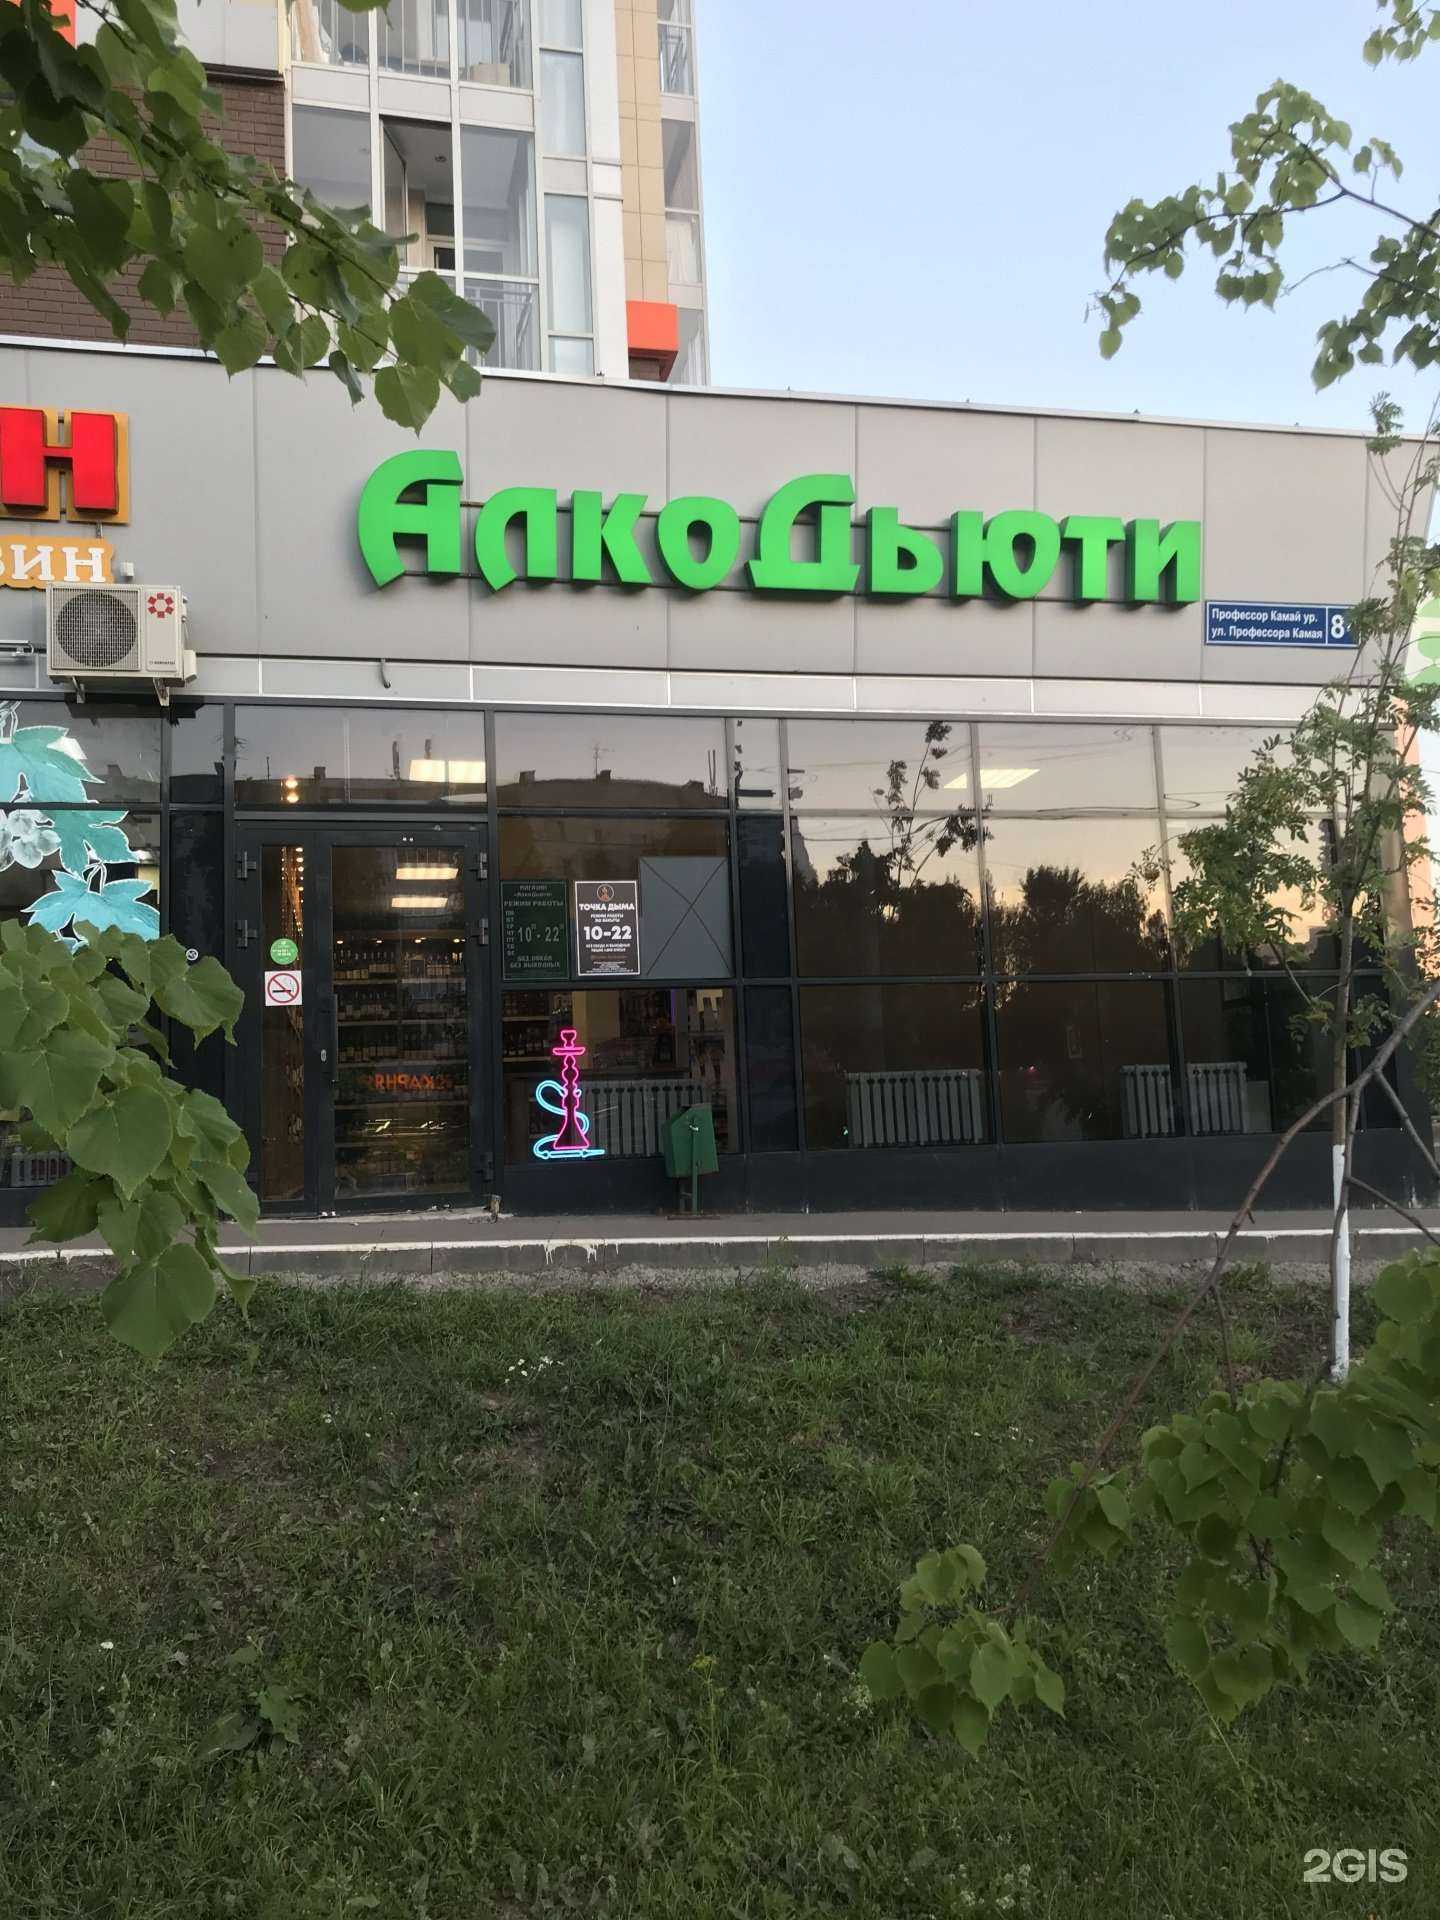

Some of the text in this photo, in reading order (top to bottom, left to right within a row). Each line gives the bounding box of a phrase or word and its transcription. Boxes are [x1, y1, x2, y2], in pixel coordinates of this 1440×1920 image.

[358, 449, 1201, 606] АлкоДьюти
[0, 544, 106, 583] ИН
[1211, 608, 1318, 624] Профессор Камай ур.
[1211, 627, 1323, 640] ул. Профессора Камая
[578, 902, 635, 912] ТОЧКА ДЫМА
[583, 926, 632, 940] 10-22
